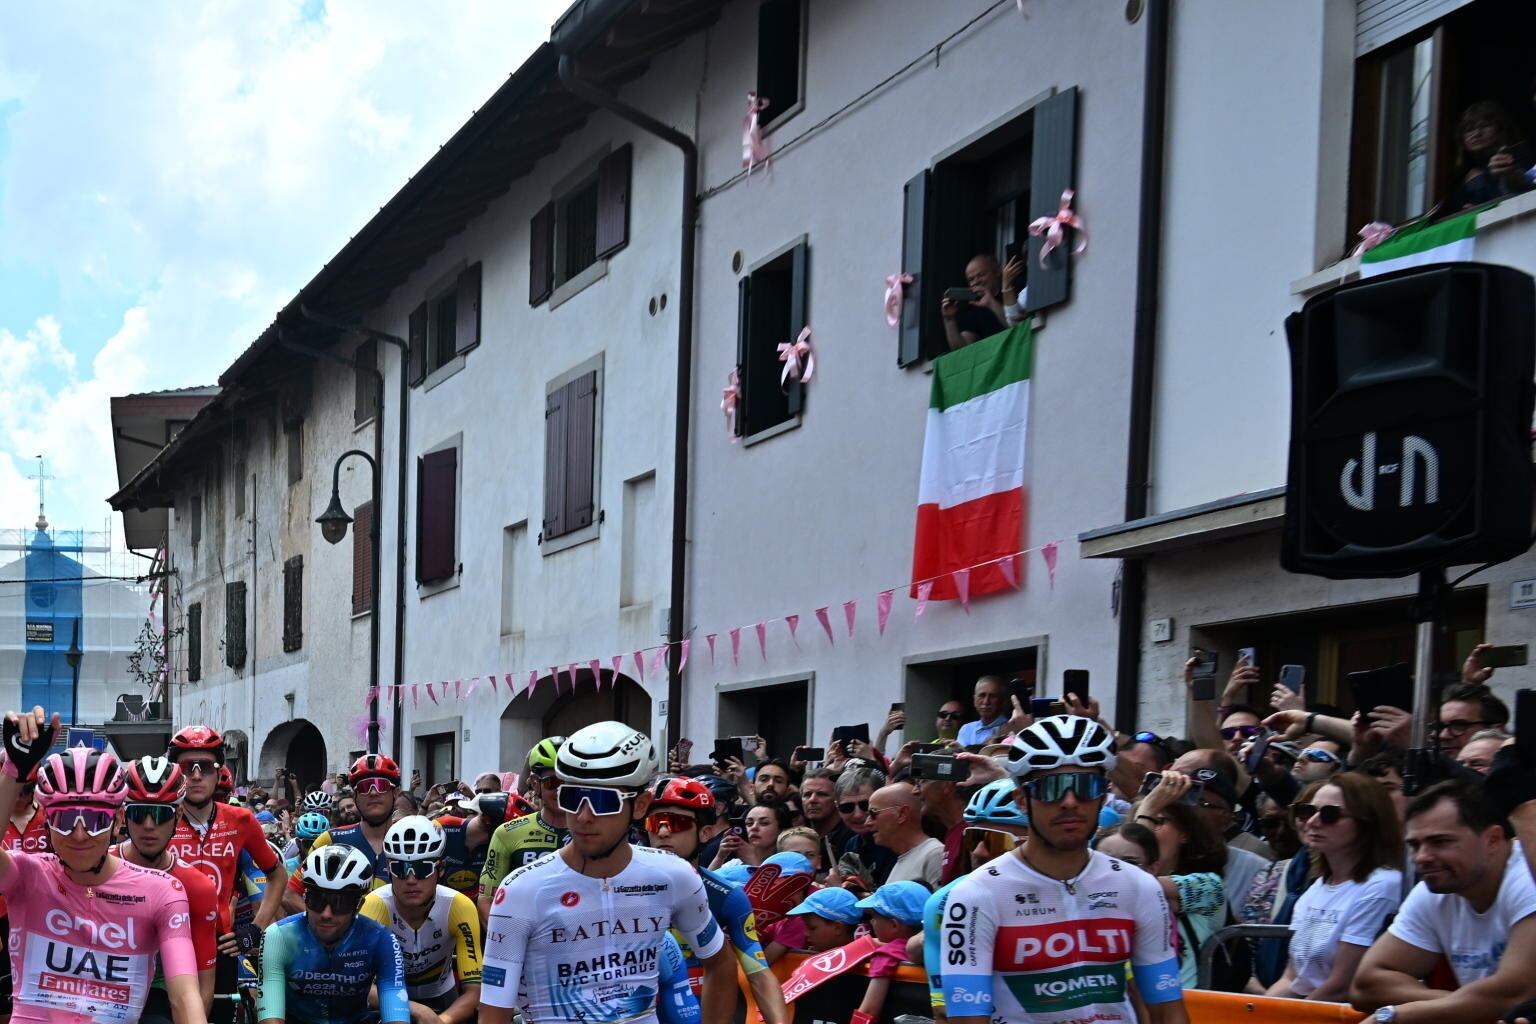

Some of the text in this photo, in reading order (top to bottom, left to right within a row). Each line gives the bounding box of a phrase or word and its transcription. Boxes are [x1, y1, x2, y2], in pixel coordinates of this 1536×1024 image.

[332, 829, 357, 837] TREK
[504, 817, 530, 829] BORA
[168, 841, 235, 857] ARKEA
[749, 868, 776, 898] TOYOTA
[1015, 907, 1057, 917] AURUM
[45, 908, 138, 951] enel
[457, 921, 478, 963] GIANT
[551, 916, 665, 944] EATALY
[946, 902, 968, 966] solo
[390, 933, 403, 987] MONDIALE
[1014, 928, 1131, 965] POLTI
[45, 941, 130, 983] UAE
[557, 946, 658, 978] BAHRAIN
[559, 961, 657, 988] VICTORIOUS
[41, 974, 128, 1001] Emirates
[951, 988, 992, 1005] eolo
[1034, 973, 1118, 997] KOMETA
